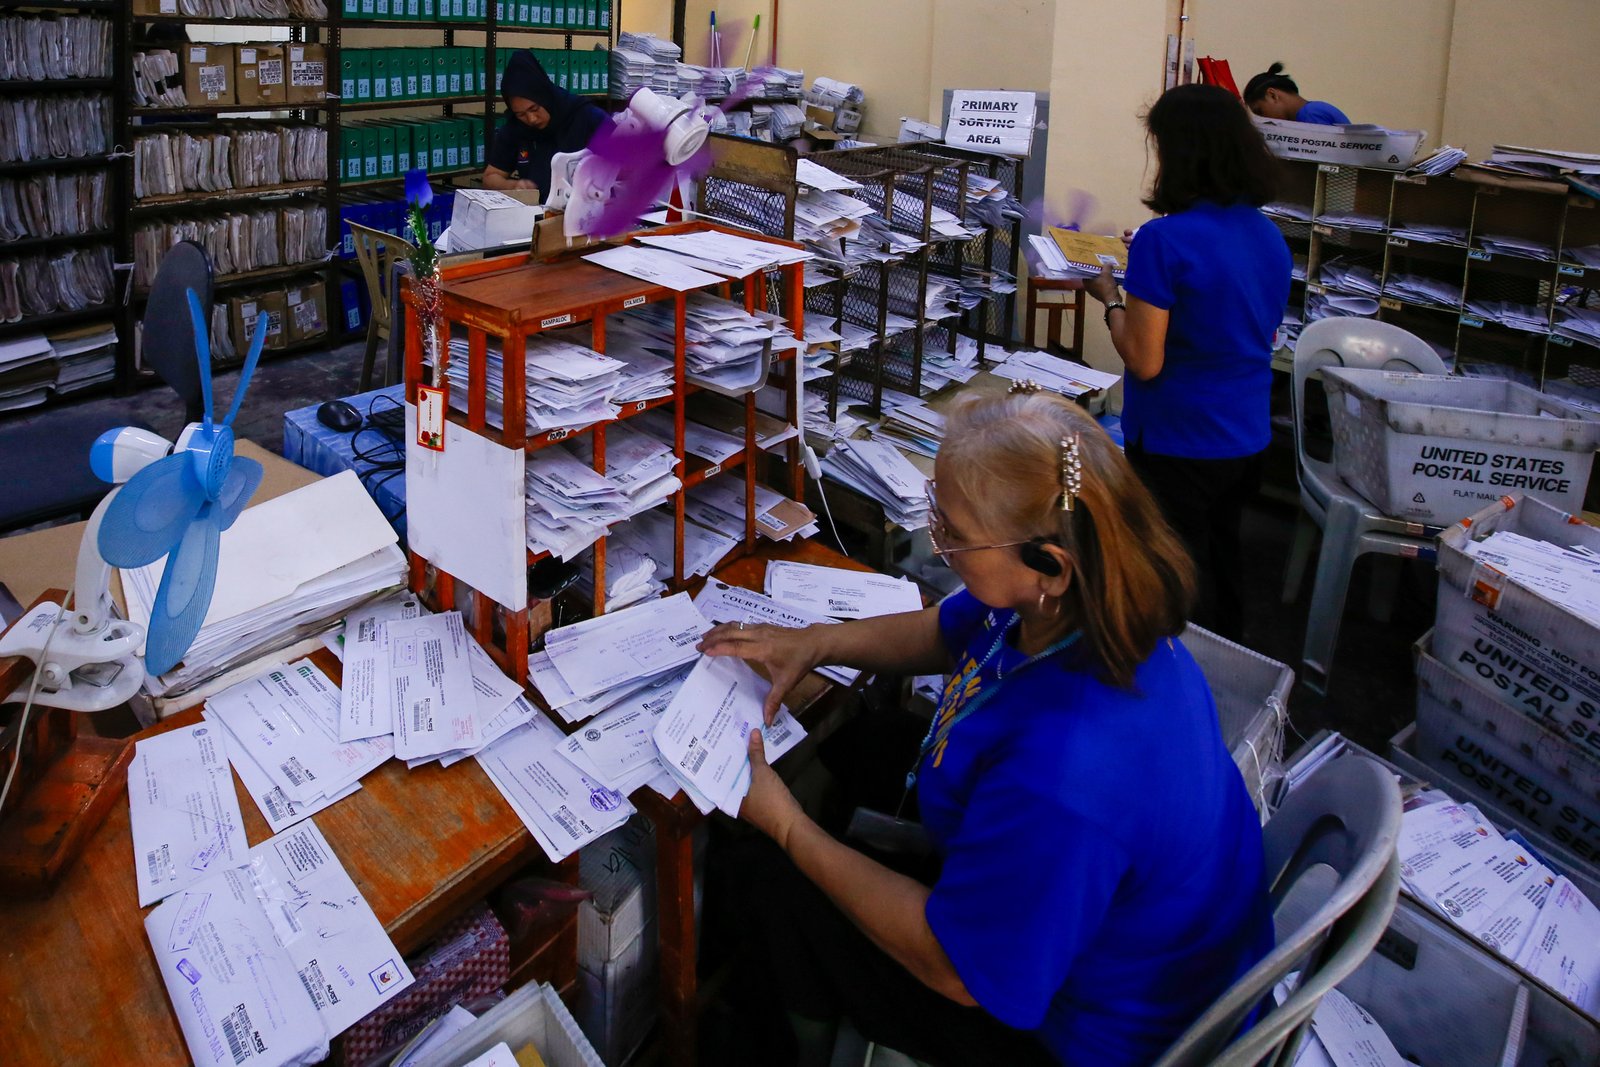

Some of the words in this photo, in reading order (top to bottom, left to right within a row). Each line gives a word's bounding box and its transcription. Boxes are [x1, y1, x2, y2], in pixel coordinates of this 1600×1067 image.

[961, 101, 1018, 111] PRIMARY
[959, 118, 1016, 128] SORTING
[967, 134, 1001, 144] AREA
[1266, 133, 1300, 144] STATES
[1302, 138, 1337, 148] POSTAL
[1340, 142, 1382, 151] SERVICE
[542, 316, 567, 326] SAMPALOC
[1421, 446, 1488, 465] UNITED
[1491, 454, 1564, 474] STATES
[1412, 462, 1484, 484] POSTAL
[1489, 472, 1571, 493] SERVICE
[1454, 490, 1474, 498] FLAT
[722, 594, 760, 608] COURT
[780, 613, 808, 624] APPE
[1487, 611, 1542, 647] WARNING
[1551, 649, 1578, 667] NOT
[1474, 638, 1570, 702] UNITED
[1459, 650, 1560, 724] POSTAL
[1455, 736, 1553, 805] UNITED
[1441, 749, 1542, 827] POSTAL
[308, 959, 318, 967] R
[235, 1003, 246, 1012] R
[190, 987, 216, 1038] REGISTERED
[209, 1036, 226, 1064] MAIL
